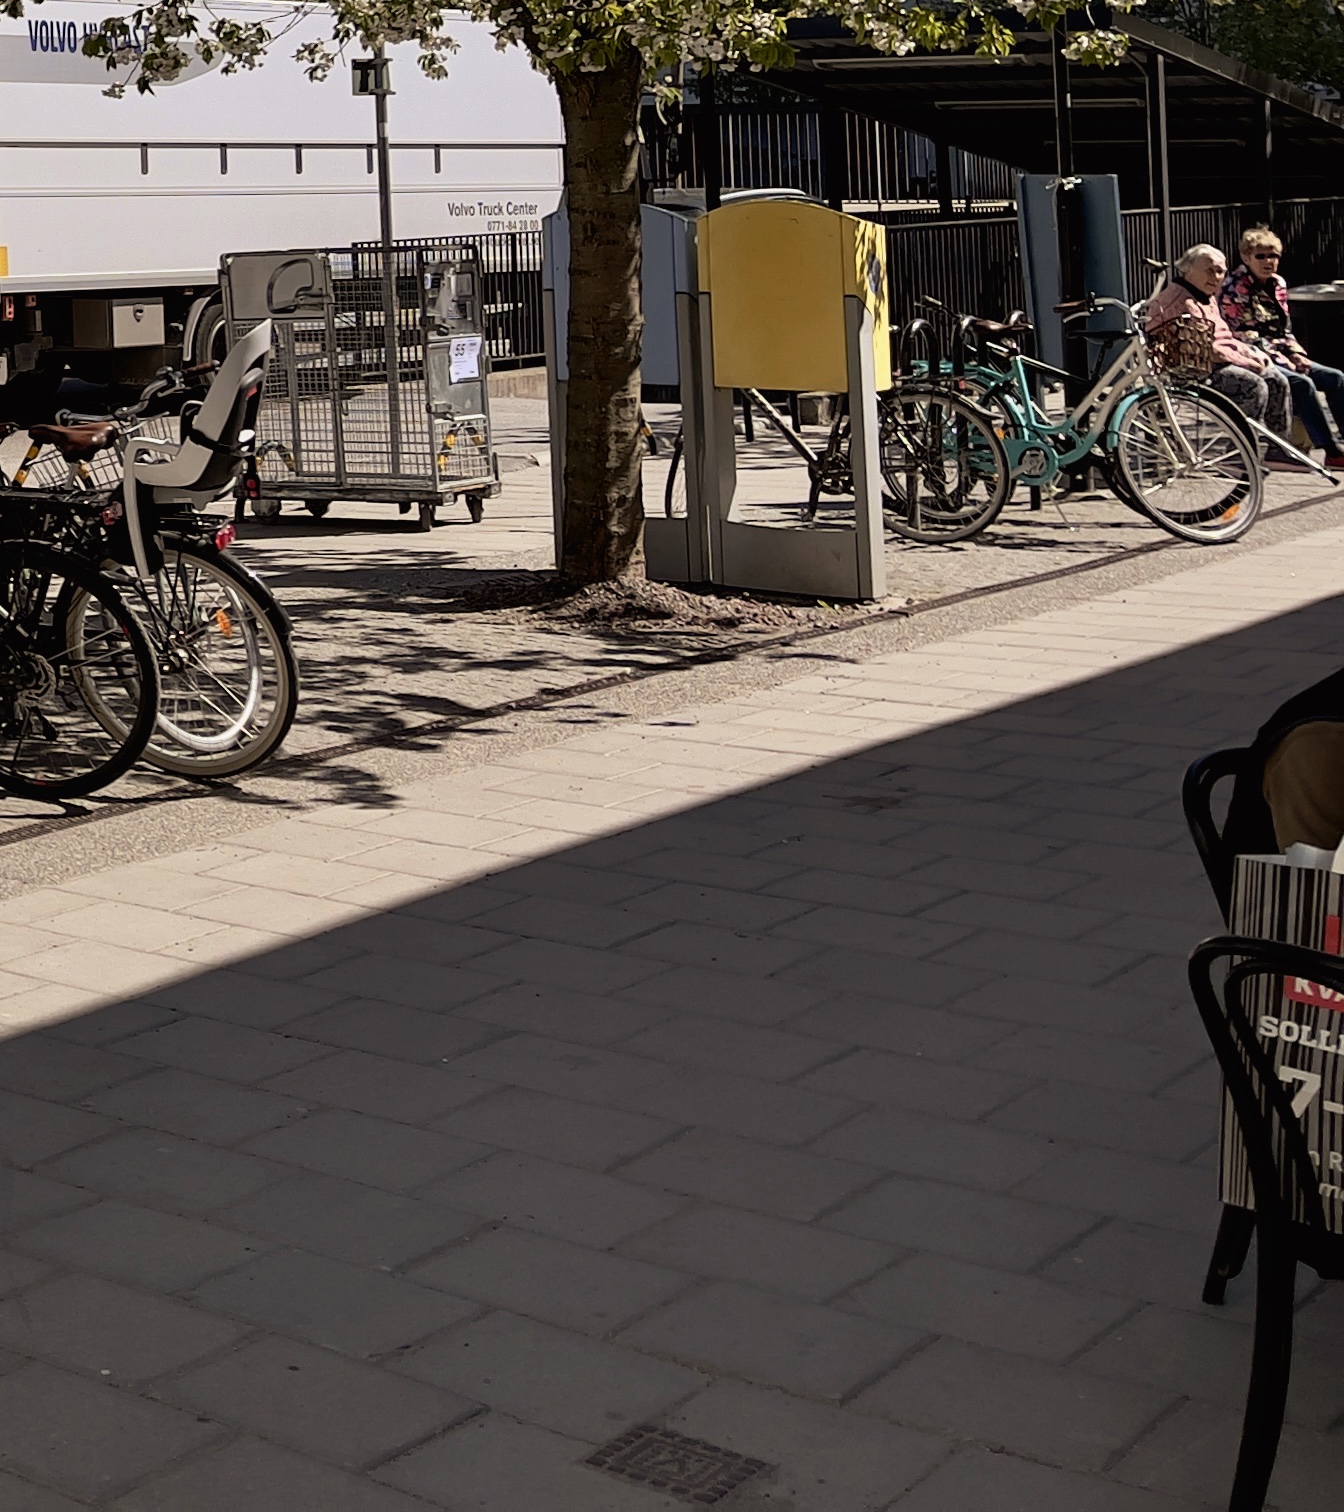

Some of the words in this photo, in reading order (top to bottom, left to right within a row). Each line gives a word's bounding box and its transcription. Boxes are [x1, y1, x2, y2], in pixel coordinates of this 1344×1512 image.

[28, 19, 77, 53] VOLVO
[447, 202, 475, 216] Volvo
[477, 201, 504, 216] Truck
[506, 201, 538, 216] Center
[519, 220, 528, 231] 28
[529, 220, 539, 231] 00
